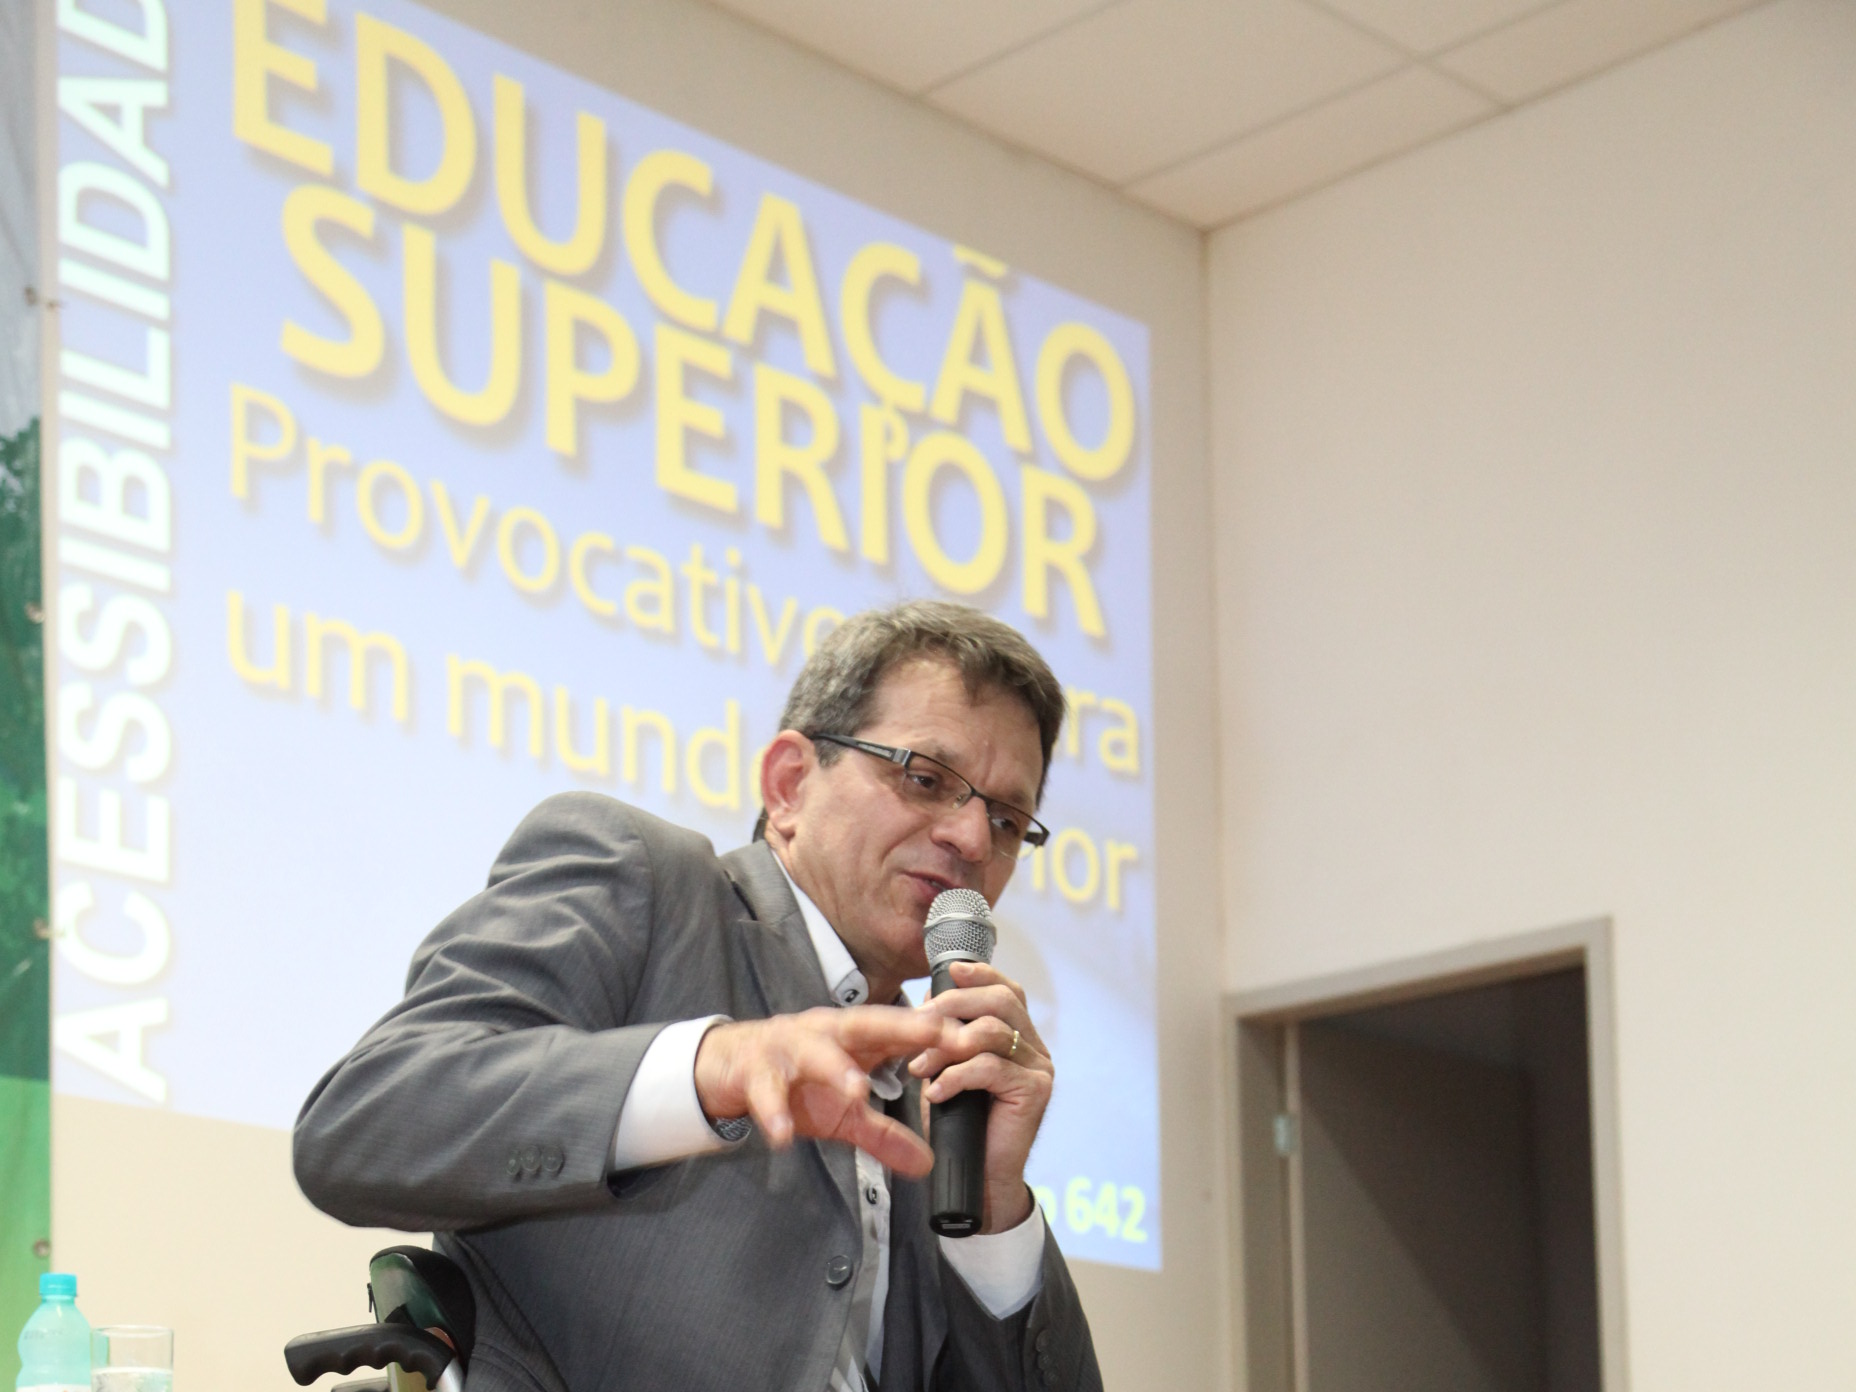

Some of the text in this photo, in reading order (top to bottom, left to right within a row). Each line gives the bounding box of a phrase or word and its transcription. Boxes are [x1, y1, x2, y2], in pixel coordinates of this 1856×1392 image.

[232, 0, 1135, 481] EDUCAÇÃO
[280, 184, 1106, 637] SUPERIOR
[227, 590, 408, 722] um
[446, 653, 766, 811] mund
[1054, 685, 1139, 774] ra
[1065, 1175, 1149, 1243] 642
